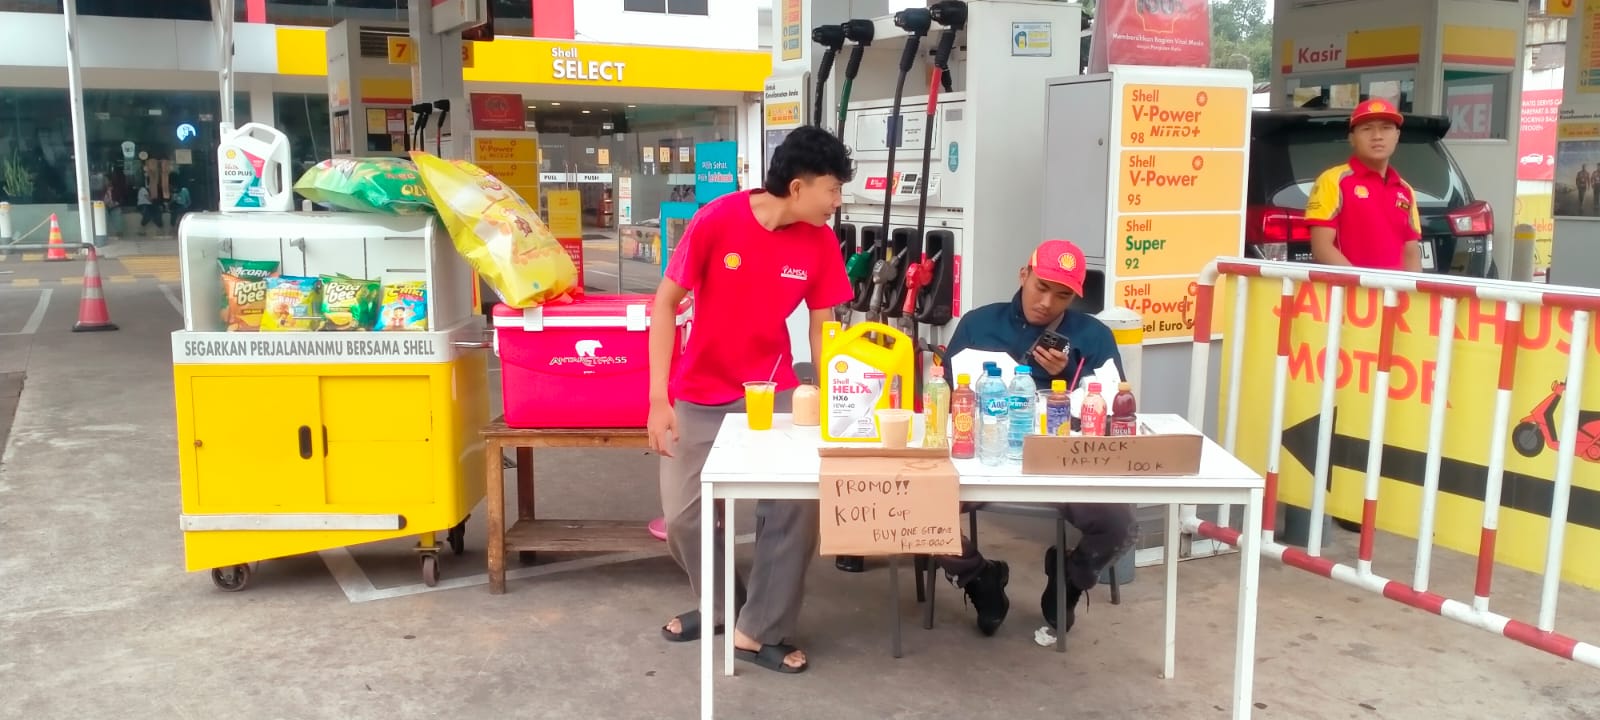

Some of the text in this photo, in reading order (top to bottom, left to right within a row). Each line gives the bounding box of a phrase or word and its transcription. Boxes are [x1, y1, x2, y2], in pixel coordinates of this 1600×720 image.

[395, 43, 407, 58] 7
[551, 47, 577, 57] Shell
[1298, 43, 1342, 64] Kasir
[552, 59, 625, 81] SELECT
[1131, 89, 1159, 102] Shell
[1132, 104, 1202, 122] V-Power
[1130, 131, 1145, 144] 98
[1129, 154, 1155, 168] Shell
[1129, 170, 1198, 187] V-Power
[1127, 193, 1141, 206] 95
[1126, 219, 1152, 232] Shell
[1125, 235, 1166, 255] Super
[1125, 258, 1139, 269] 92
[328, 289, 356, 304] bee
[1124, 283, 1151, 296] Shell
[237, 289, 265, 305] bee
[1124, 298, 1194, 314] V-Power
[1160, 320, 1183, 331] Euro
[184, 339, 435, 356] SEGARKAN PERJALANANMU BERSAMA SHELL
[549, 356, 627, 367] ANTARCTICA 55
[832, 383, 872, 394] HELIX
[1127, 460, 1151, 471] 100
[835, 479, 910, 497] PROMO!!
[873, 528, 897, 543] BUY
[901, 526, 918, 537] ONE
